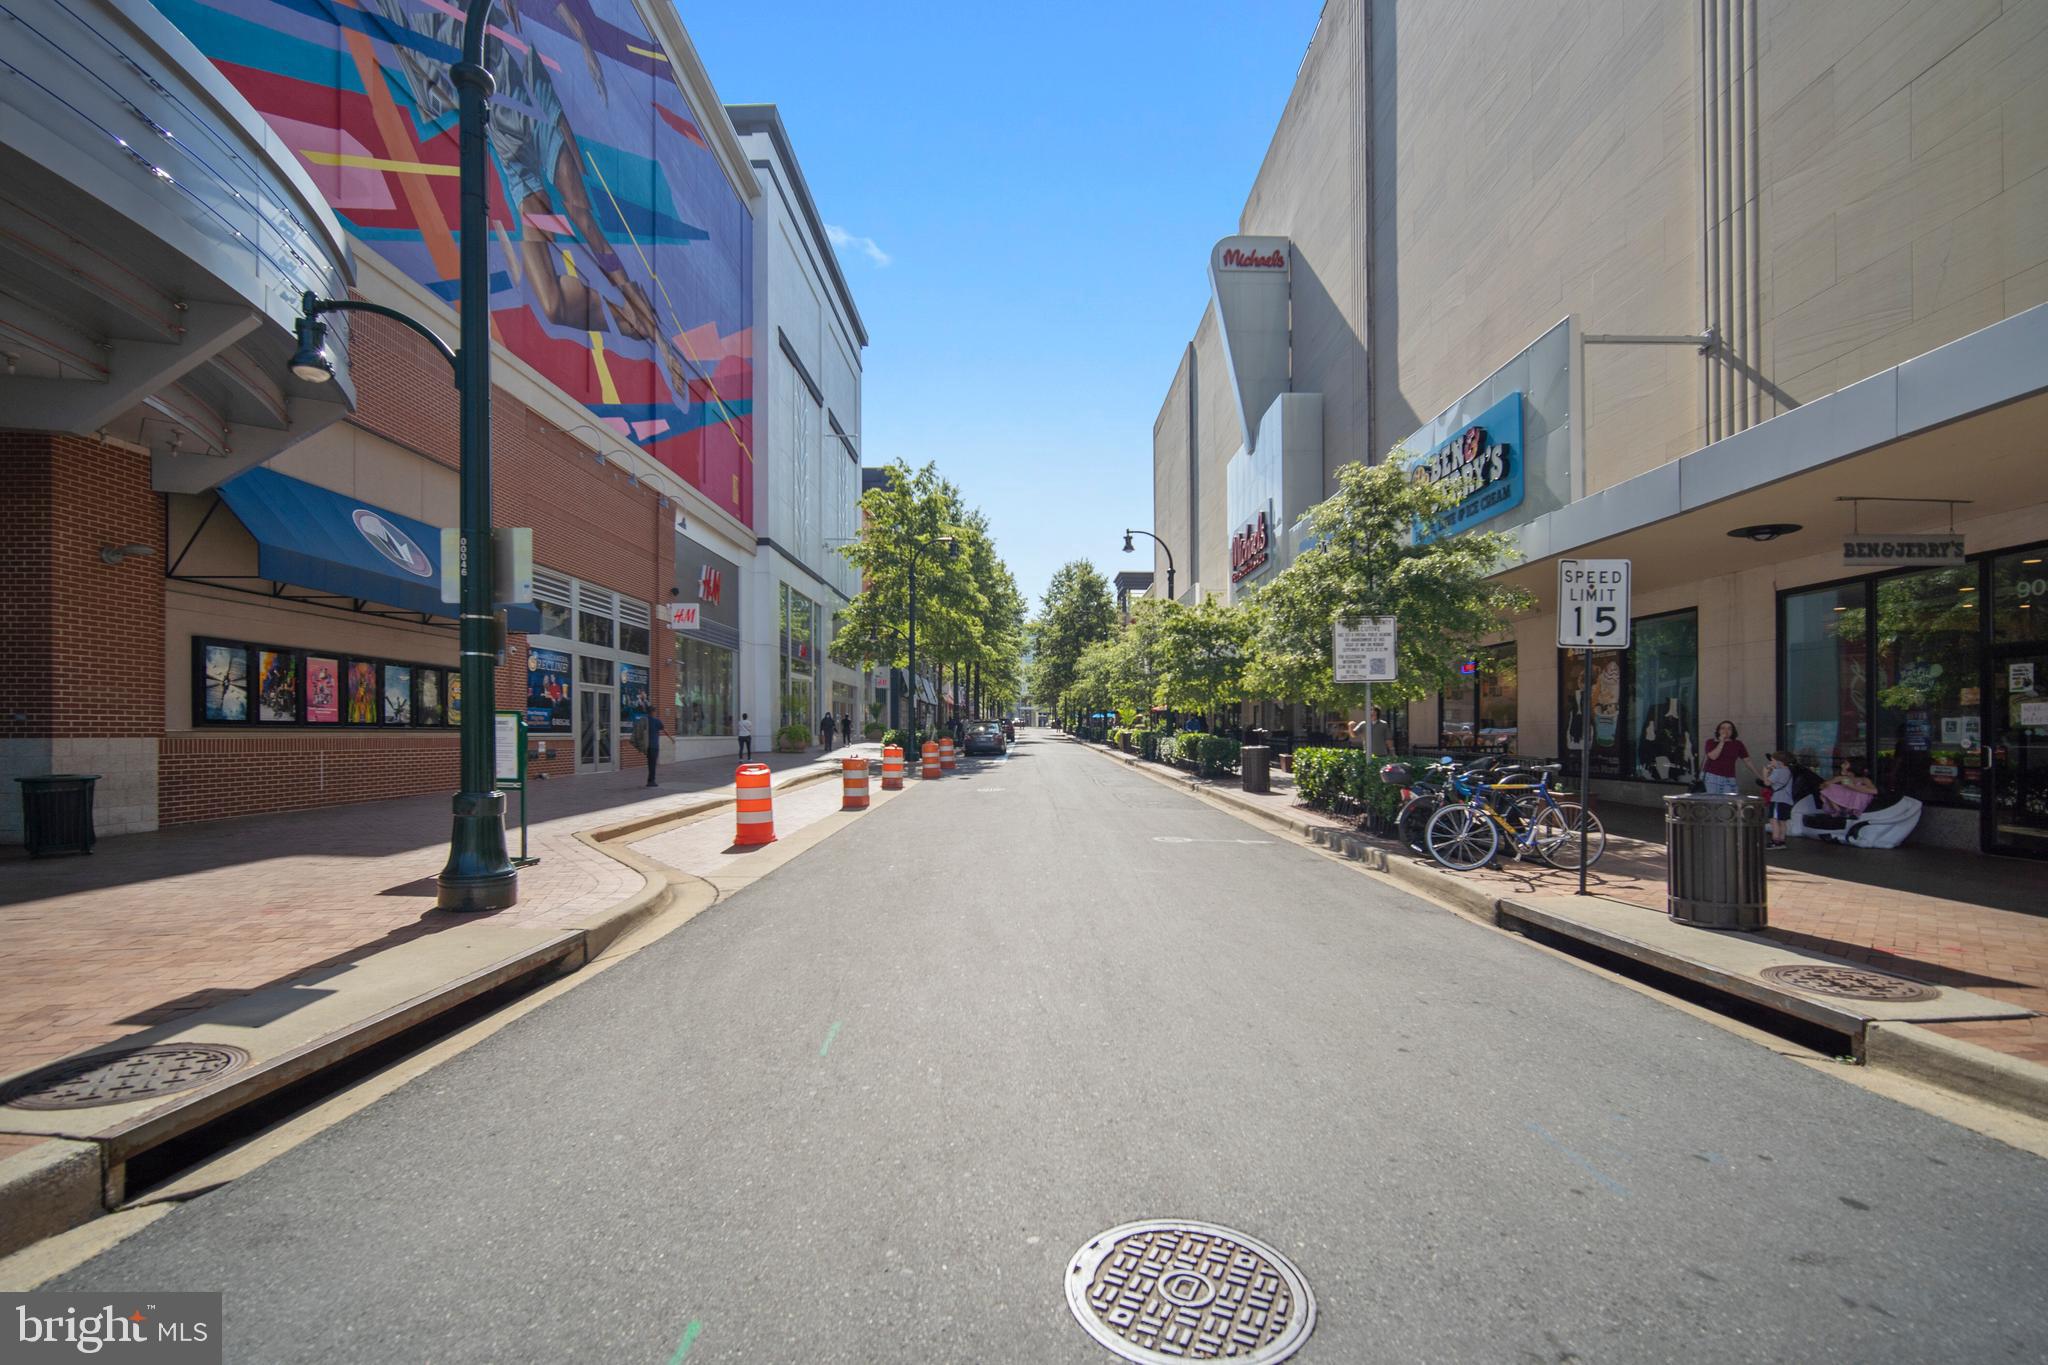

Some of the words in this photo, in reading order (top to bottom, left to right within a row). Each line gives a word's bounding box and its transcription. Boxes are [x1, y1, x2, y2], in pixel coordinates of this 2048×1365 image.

[1223, 248, 1285, 268] Michaels
[1429, 434, 1466, 486] BEN
[1481, 484, 1512, 510] CREAM
[698, 564, 721, 606] H&M
[1564, 570, 1622, 584] SPEED
[1570, 588, 1616, 602] LIMIT
[673, 608, 696, 623] H&M
[1574, 606, 1617, 637] 15
